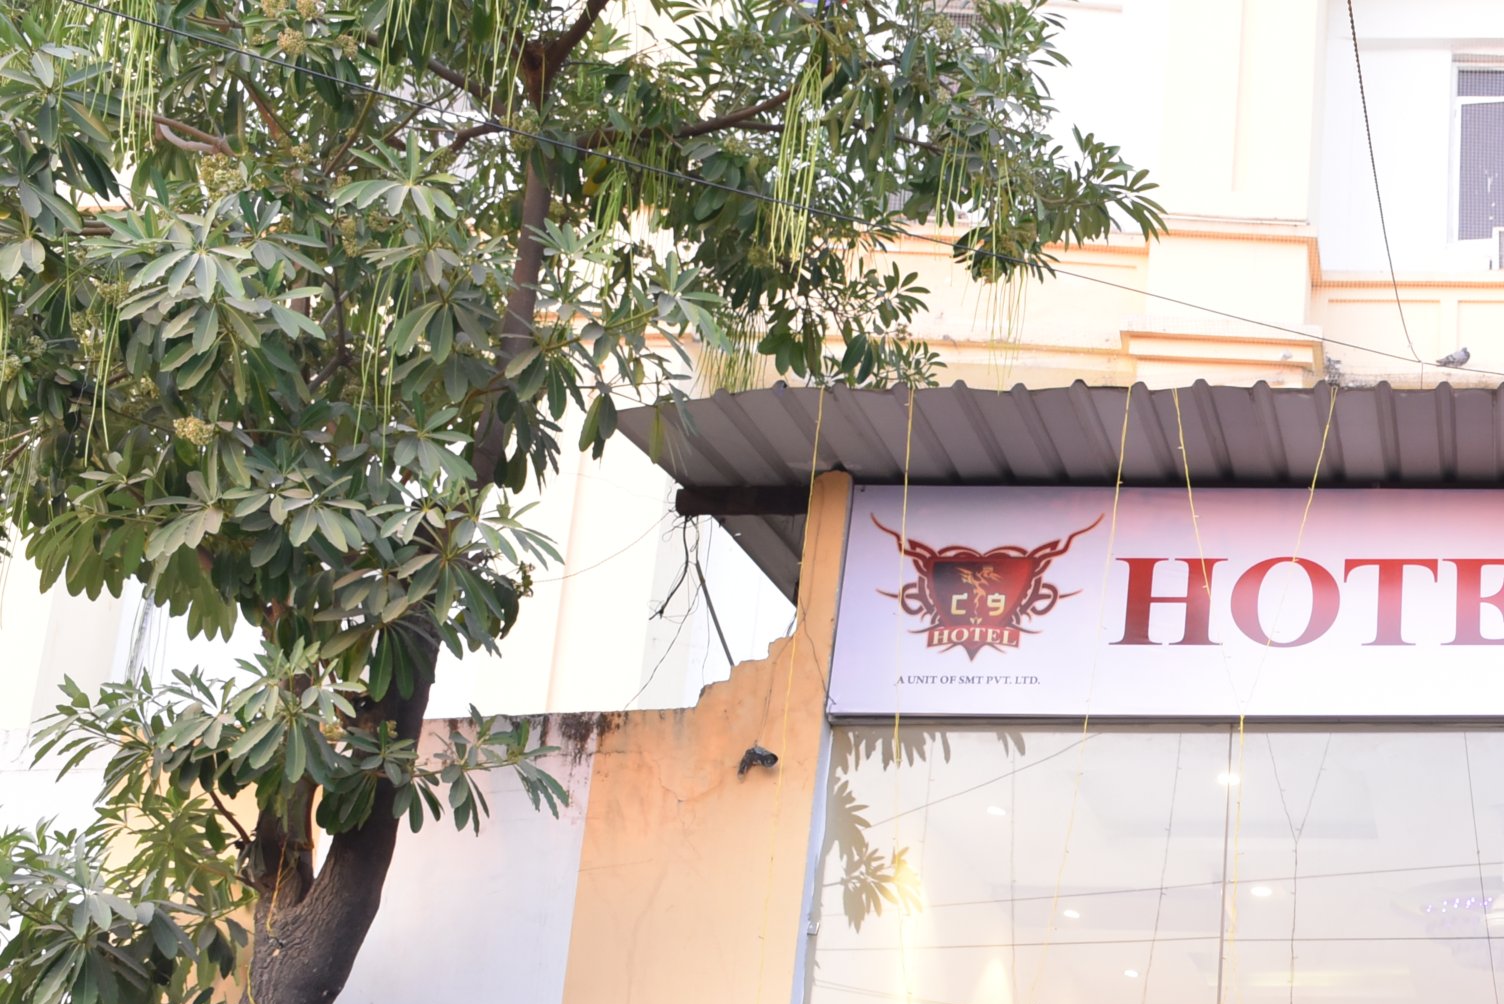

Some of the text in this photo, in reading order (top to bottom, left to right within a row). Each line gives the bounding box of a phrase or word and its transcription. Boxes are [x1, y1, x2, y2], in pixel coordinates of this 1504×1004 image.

[951, 592, 1006, 616] C 9
[932, 626, 1018, 646] HOTEL
[896, 675, 1041, 685] A UNIT OF SMT PVT. LTD.
